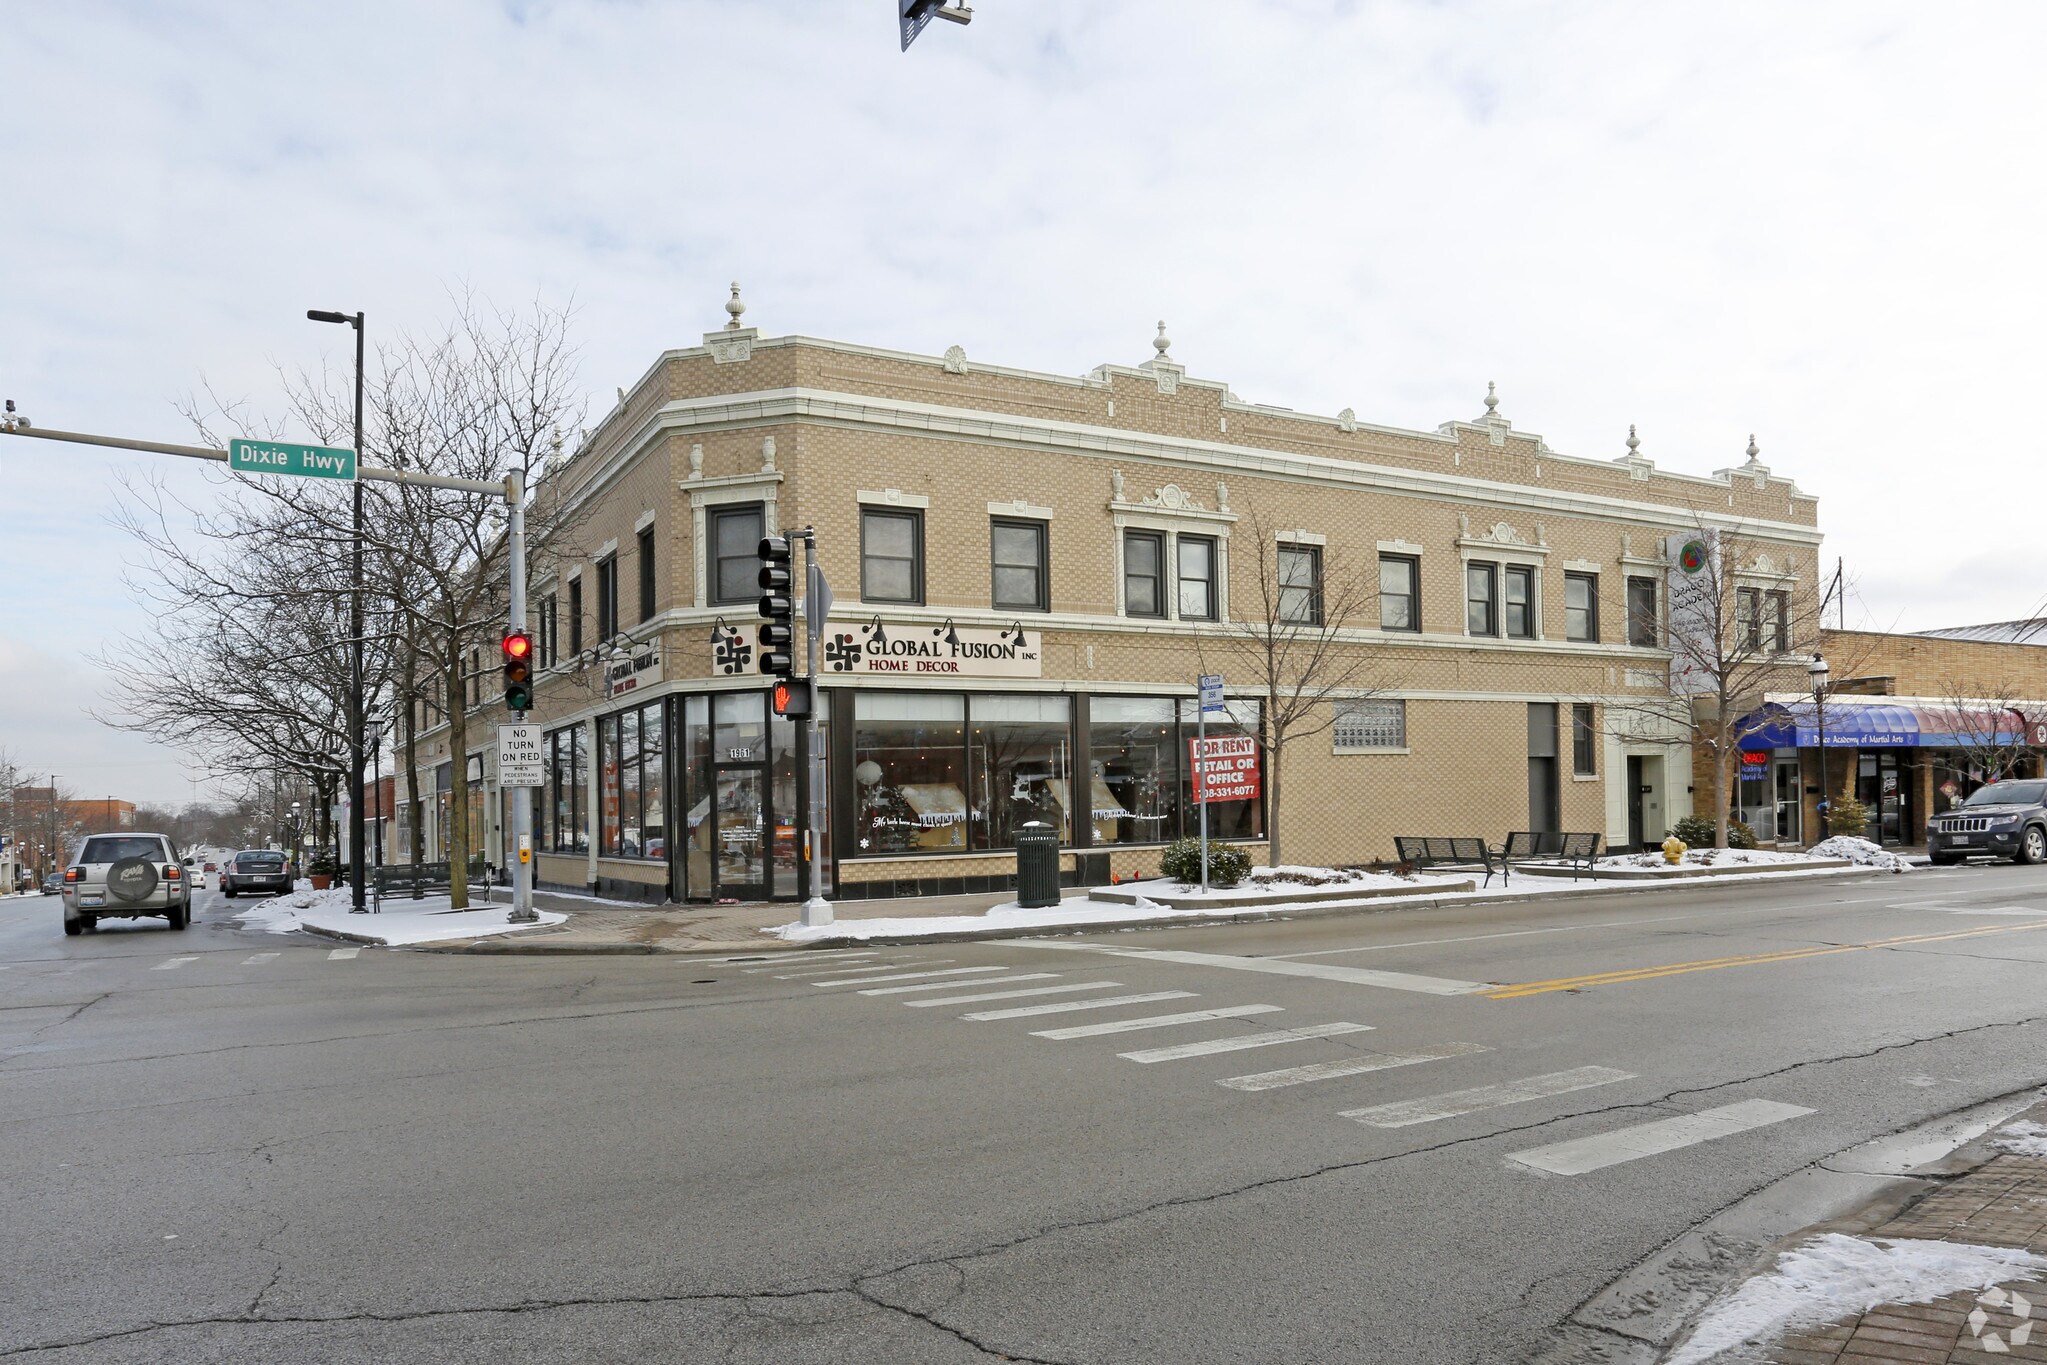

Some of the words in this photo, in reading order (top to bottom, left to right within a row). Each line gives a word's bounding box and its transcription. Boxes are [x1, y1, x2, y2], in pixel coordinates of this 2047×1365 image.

[240, 444, 288, 466] Dixie
[303, 450, 346, 474] Hwy
[866, 639, 943, 657] GLOBAL
[950, 641, 1016, 660] FUSION
[1022, 652, 1038, 660] INC
[869, 659, 909, 671] HOME
[916, 661, 960, 673] DECOR
[513, 730, 527, 738] NO
[508, 741, 534, 750] TURN
[1832, 735, 1859, 746] Academy
[1861, 735, 1868, 744] of
[1869, 735, 1890, 744] Martial
[1892, 735, 1904, 744] Arts
[1196, 741, 1219, 755] FOR
[1222, 739, 1252, 754] RENT
[502, 753, 516, 761] ON
[520, 752, 540, 761] RED
[731, 749, 749, 757] 1961
[1743, 753, 1767, 763] DRACO
[1236, 758, 1255, 770] OR
[1206, 772, 1245, 785] OFFICE
